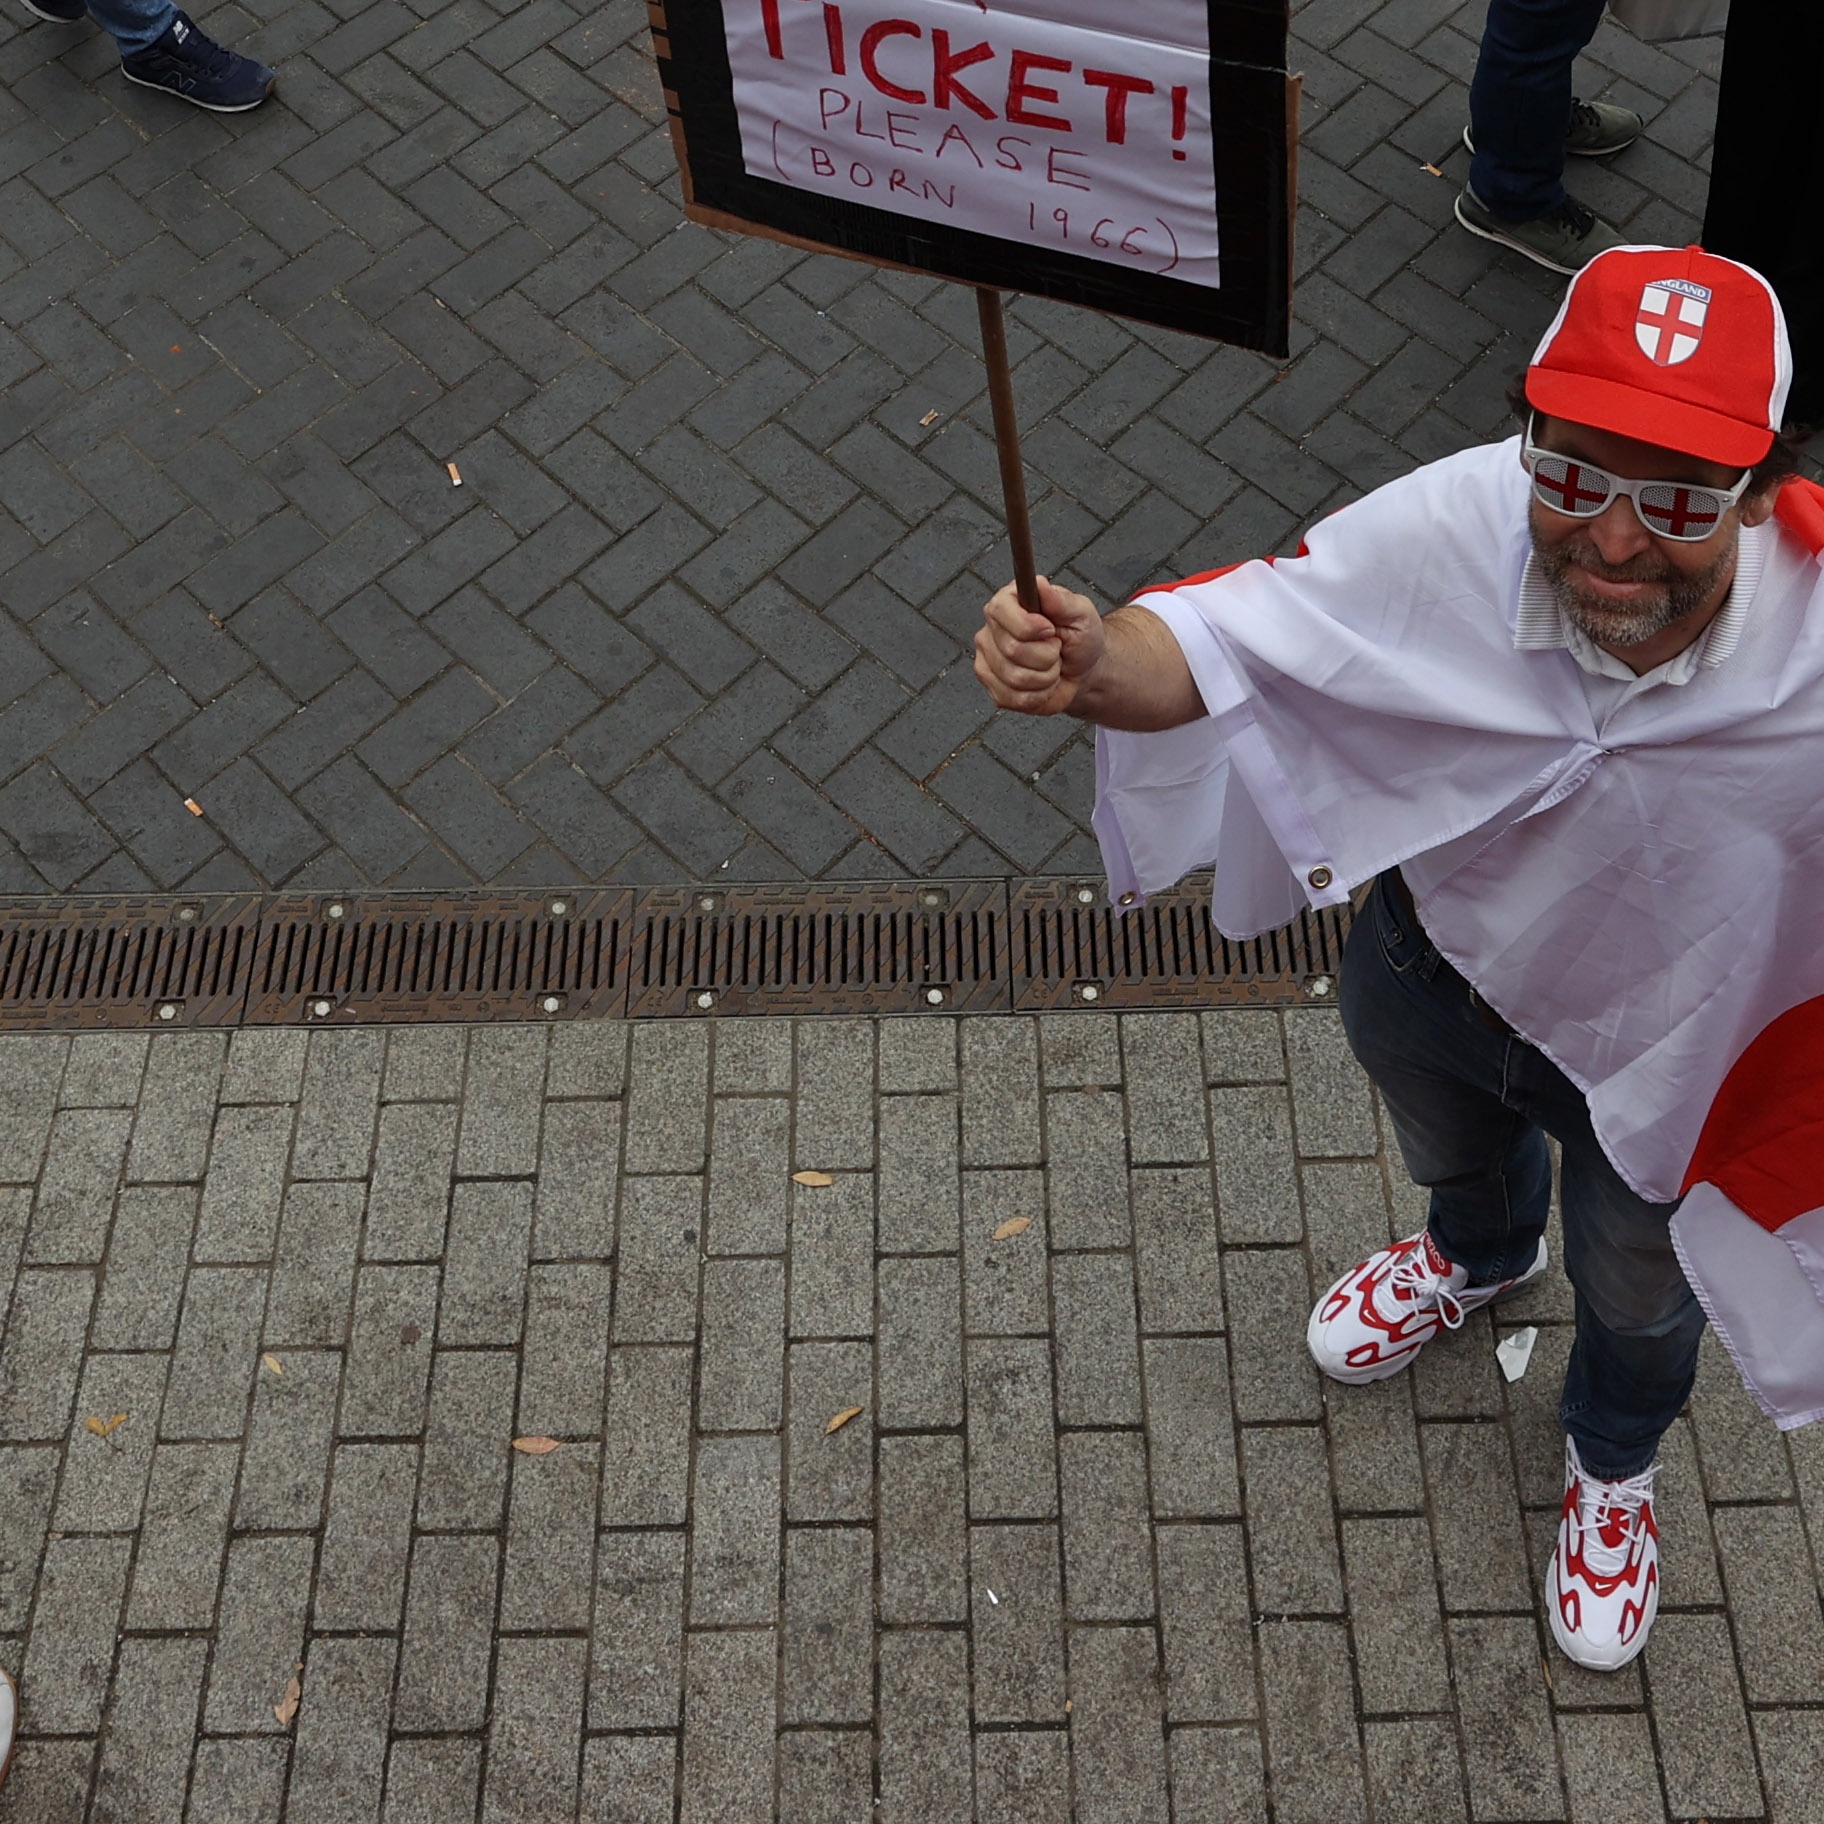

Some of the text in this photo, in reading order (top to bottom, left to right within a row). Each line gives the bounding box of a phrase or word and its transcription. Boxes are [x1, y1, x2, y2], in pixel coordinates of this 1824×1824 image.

[819, 87, 1093, 193] PLEASE
[771, 118, 1182, 275] (BORN 1966)
[1656, 279, 1707, 298] NGLAND
